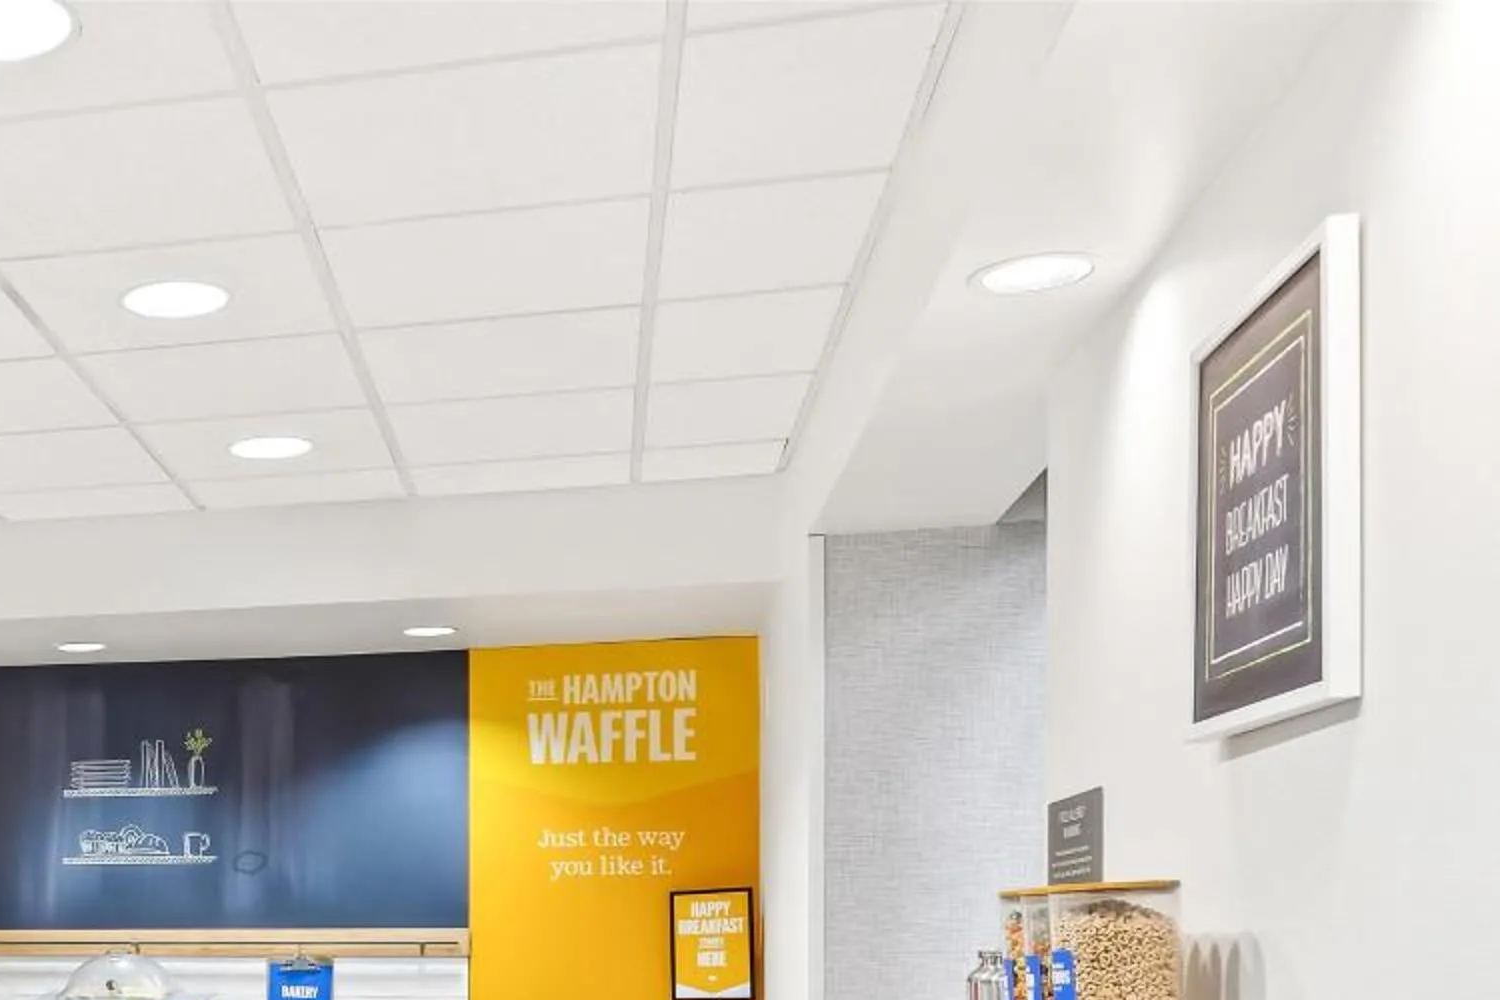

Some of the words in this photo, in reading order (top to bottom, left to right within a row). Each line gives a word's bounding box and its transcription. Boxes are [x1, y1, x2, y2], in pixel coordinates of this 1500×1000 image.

[1229, 399, 1286, 489] HAPPY
[1225, 473, 1290, 556] BREAKFAST
[1226, 557, 1263, 619] HAPPY
[1265, 543, 1289, 600] DAY
[529, 679, 557, 697] THE
[563, 669, 697, 705] HAMPTON
[527, 707, 697, 765] WAFFLE
[538, 829, 586, 849] Just
[593, 826, 631, 847] the
[637, 831, 685, 851] way
[550, 860, 593, 882] you
[601, 856, 643, 876] like
[651, 856, 673, 876] it.
[691, 901, 731, 918] HAPPY
[678, 917, 743, 935] BREAKFAST
[281, 985, 318, 999] BAKERY
